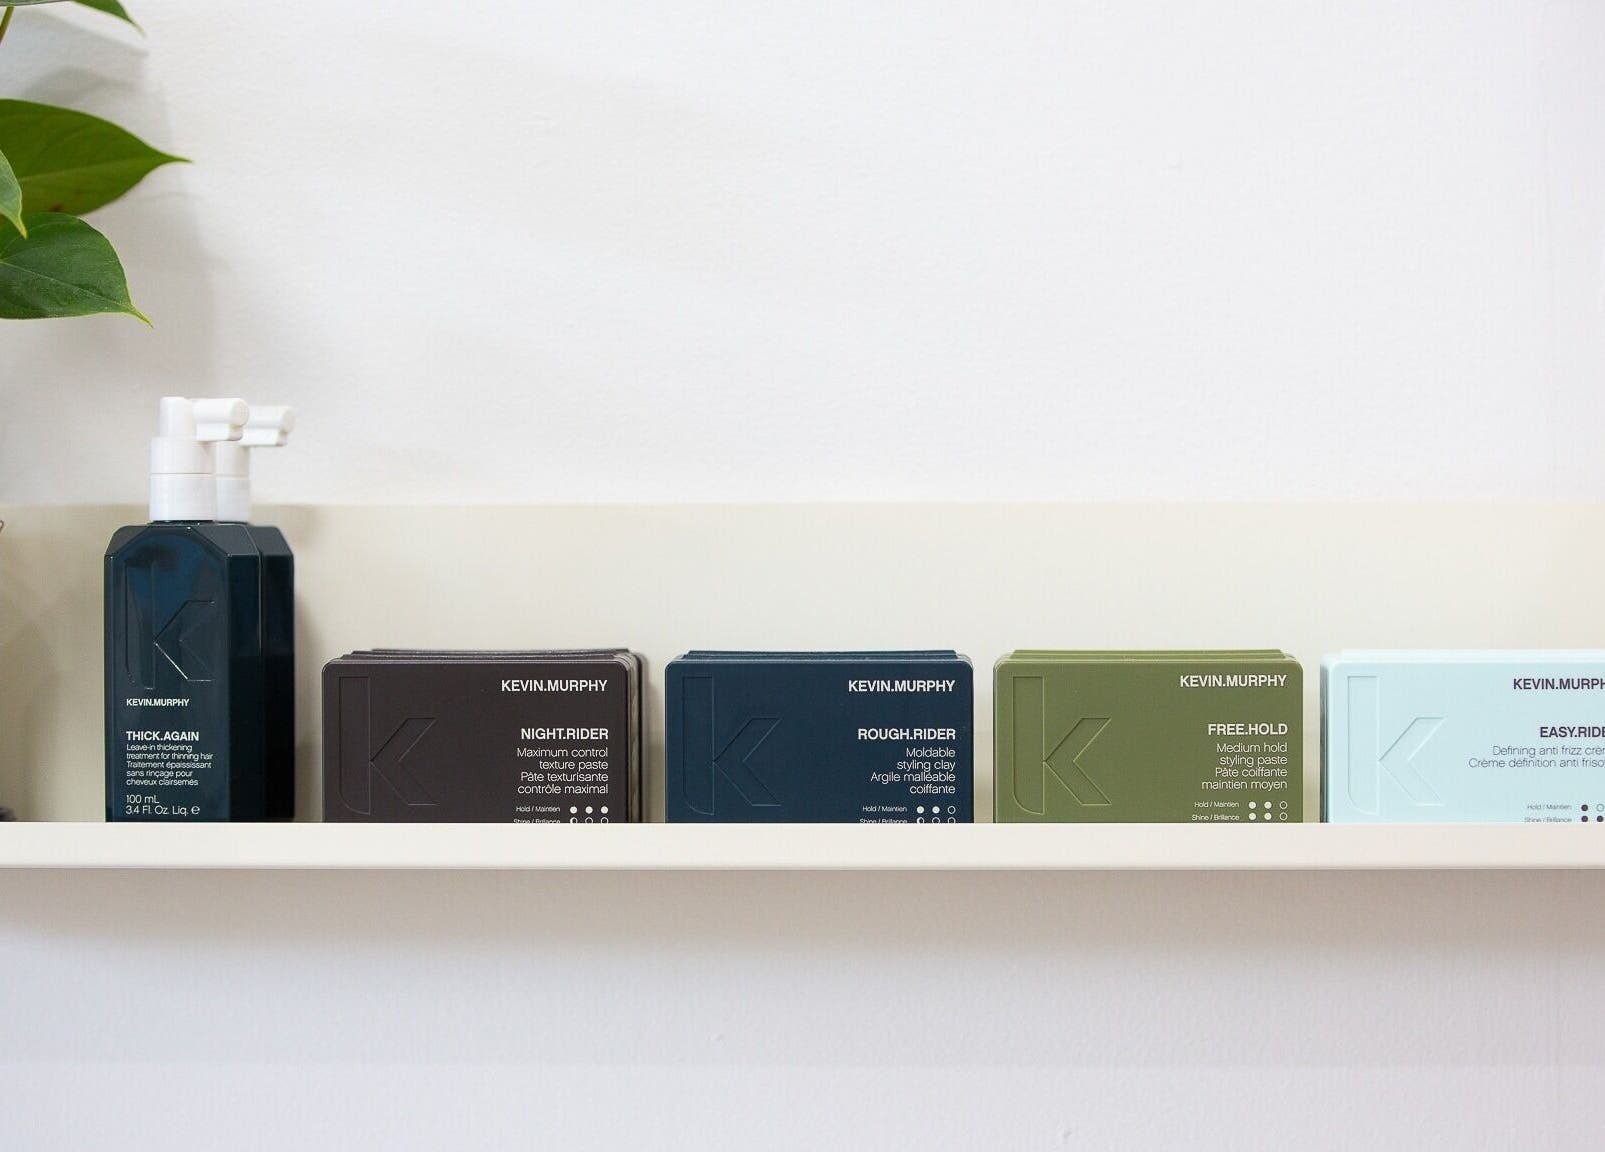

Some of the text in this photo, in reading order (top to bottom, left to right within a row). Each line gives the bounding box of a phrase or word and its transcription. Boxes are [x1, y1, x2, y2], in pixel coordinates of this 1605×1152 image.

[501, 679, 608, 692] KEVIN.MURPHY
[848, 679, 956, 692] KEVIN.MURPHY
[1180, 674, 1287, 687] KEVIN.MURPHY
[126, 698, 190, 707] KEVIN.MURPHY
[521, 728, 609, 740] NIGHT.RIDER
[857, 728, 956, 740] ROUGH.RIDER
[1207, 723, 1288, 736] FREE.HOLD
[125, 731, 200, 741] THICK.AGAIN
[126, 743, 193, 753] Leave-in thickening
[517, 747, 608, 757] Maximum control
[905, 747, 956, 758] Moldable
[1216, 742, 1288, 753] Medium hold
[1492, 745, 1536, 758] Defining
[1539, 745, 1559, 756] anti
[1561, 745, 1582, 756] frizz
[126, 752, 214, 762] treatment for thinning hair
[1219, 754, 1288, 767] styling paste
[1468, 757, 1605, 768] Crème définition anti friso
[126, 760, 212, 770] Traitement épaississant
[539, 760, 609, 771] texture paste
[896, 759, 956, 772] styling clay
[145, 770, 175, 779] rinçage
[175, 770, 193, 779] pour
[520, 771, 609, 782] Pâte texturisante
[870, 771, 956, 784] Argile malléable
[1215, 766, 1288, 778] Pâte coiffante
[158, 778, 199, 786] clairsemés
[1202, 779, 1288, 791] maintien moyen
[517, 784, 608, 794] contrôle maximal
[909, 783, 956, 794] coiffante
[126, 794, 160, 804] 100 mL
